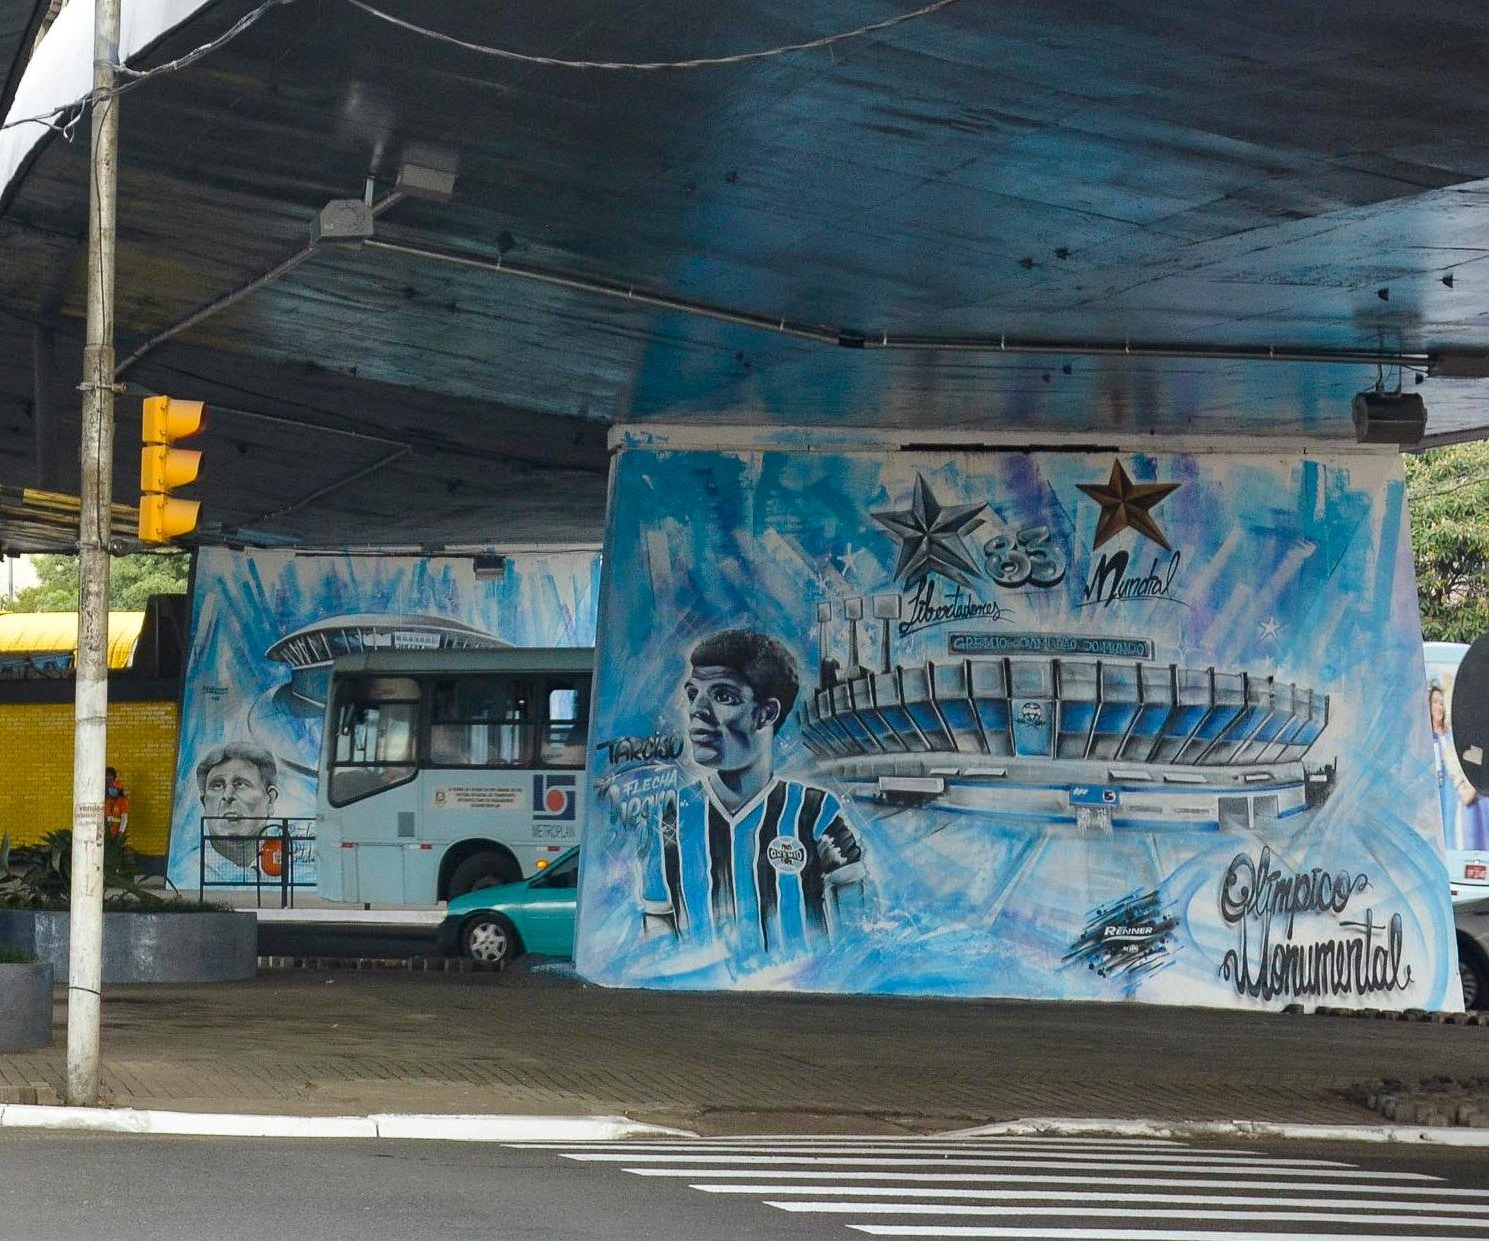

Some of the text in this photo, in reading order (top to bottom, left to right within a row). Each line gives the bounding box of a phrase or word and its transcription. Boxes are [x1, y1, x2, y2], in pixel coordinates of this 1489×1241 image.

[983, 523, 1067, 589] 83
[1084, 549, 1181, 607] Mundial
[898, 574, 1001, 633] Libertadores
[622, 769, 679, 797] FLECHA
[1103, 925, 1153, 936] RENNER
[1218, 906, 1415, 1001] Monumental
